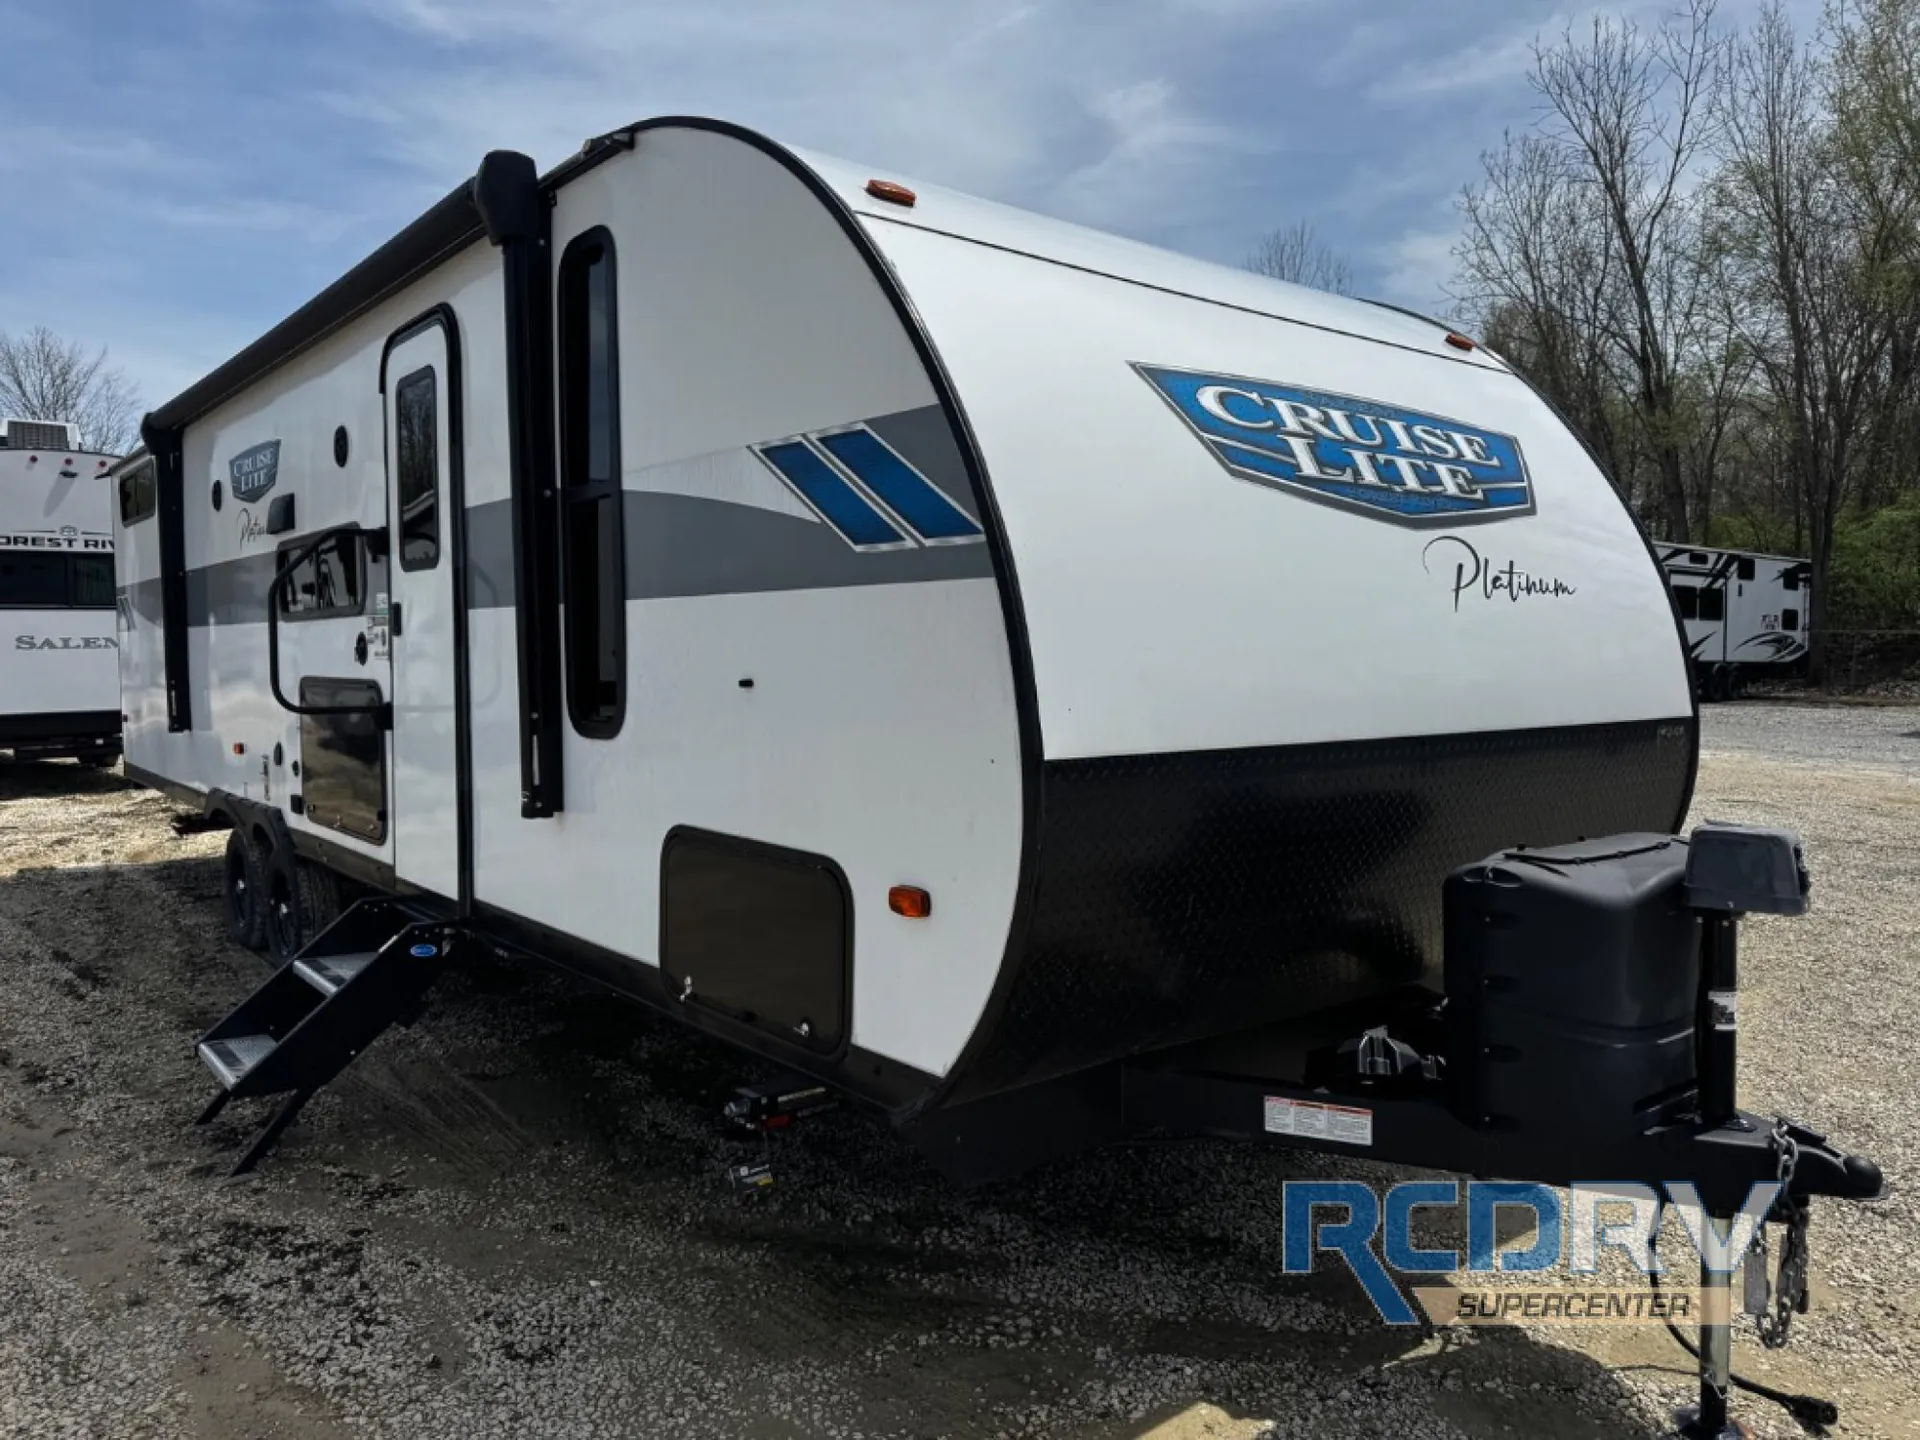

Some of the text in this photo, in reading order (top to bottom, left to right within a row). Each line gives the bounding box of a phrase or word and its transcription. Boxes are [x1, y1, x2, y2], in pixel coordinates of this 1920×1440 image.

[1195, 384, 1502, 468] CRUISE
[234, 447, 275, 477] CRUISE
[241, 470, 267, 493] LITE
[1278, 434, 1484, 501] LITE
[0, 535, 77, 548] OREST
[1422, 535, 1576, 612] Platinum
